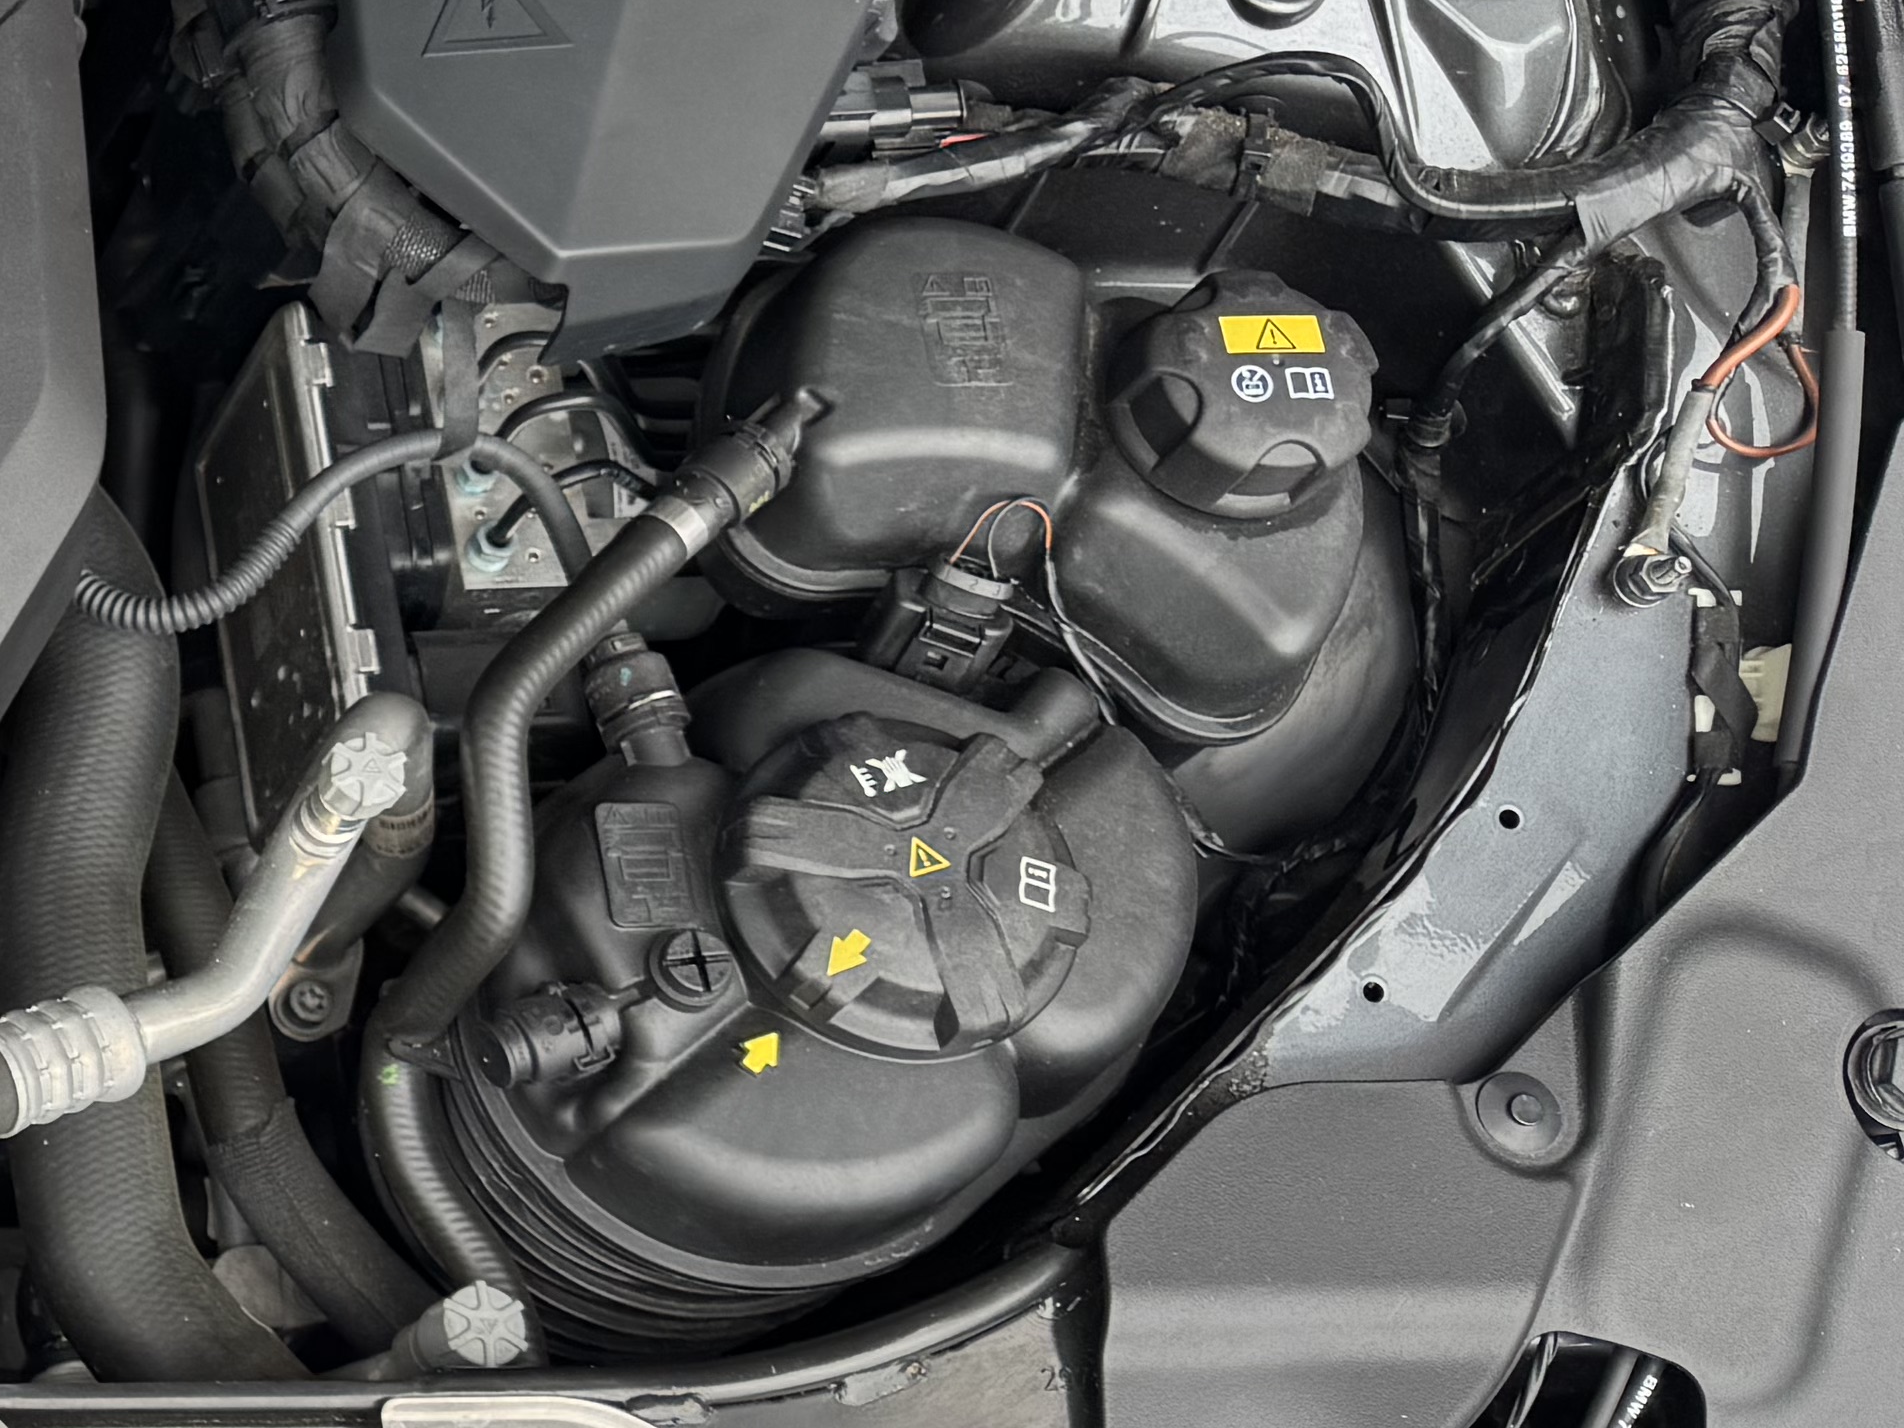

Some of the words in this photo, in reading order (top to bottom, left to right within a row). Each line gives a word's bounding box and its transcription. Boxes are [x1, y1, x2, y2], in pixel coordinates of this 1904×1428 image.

[1839, 84, 1853, 108] 07
[1839, 120, 1855, 191] 7419389
[1842, 193, 1857, 237] BMW
[1626, 1374, 1659, 1420] BMW
